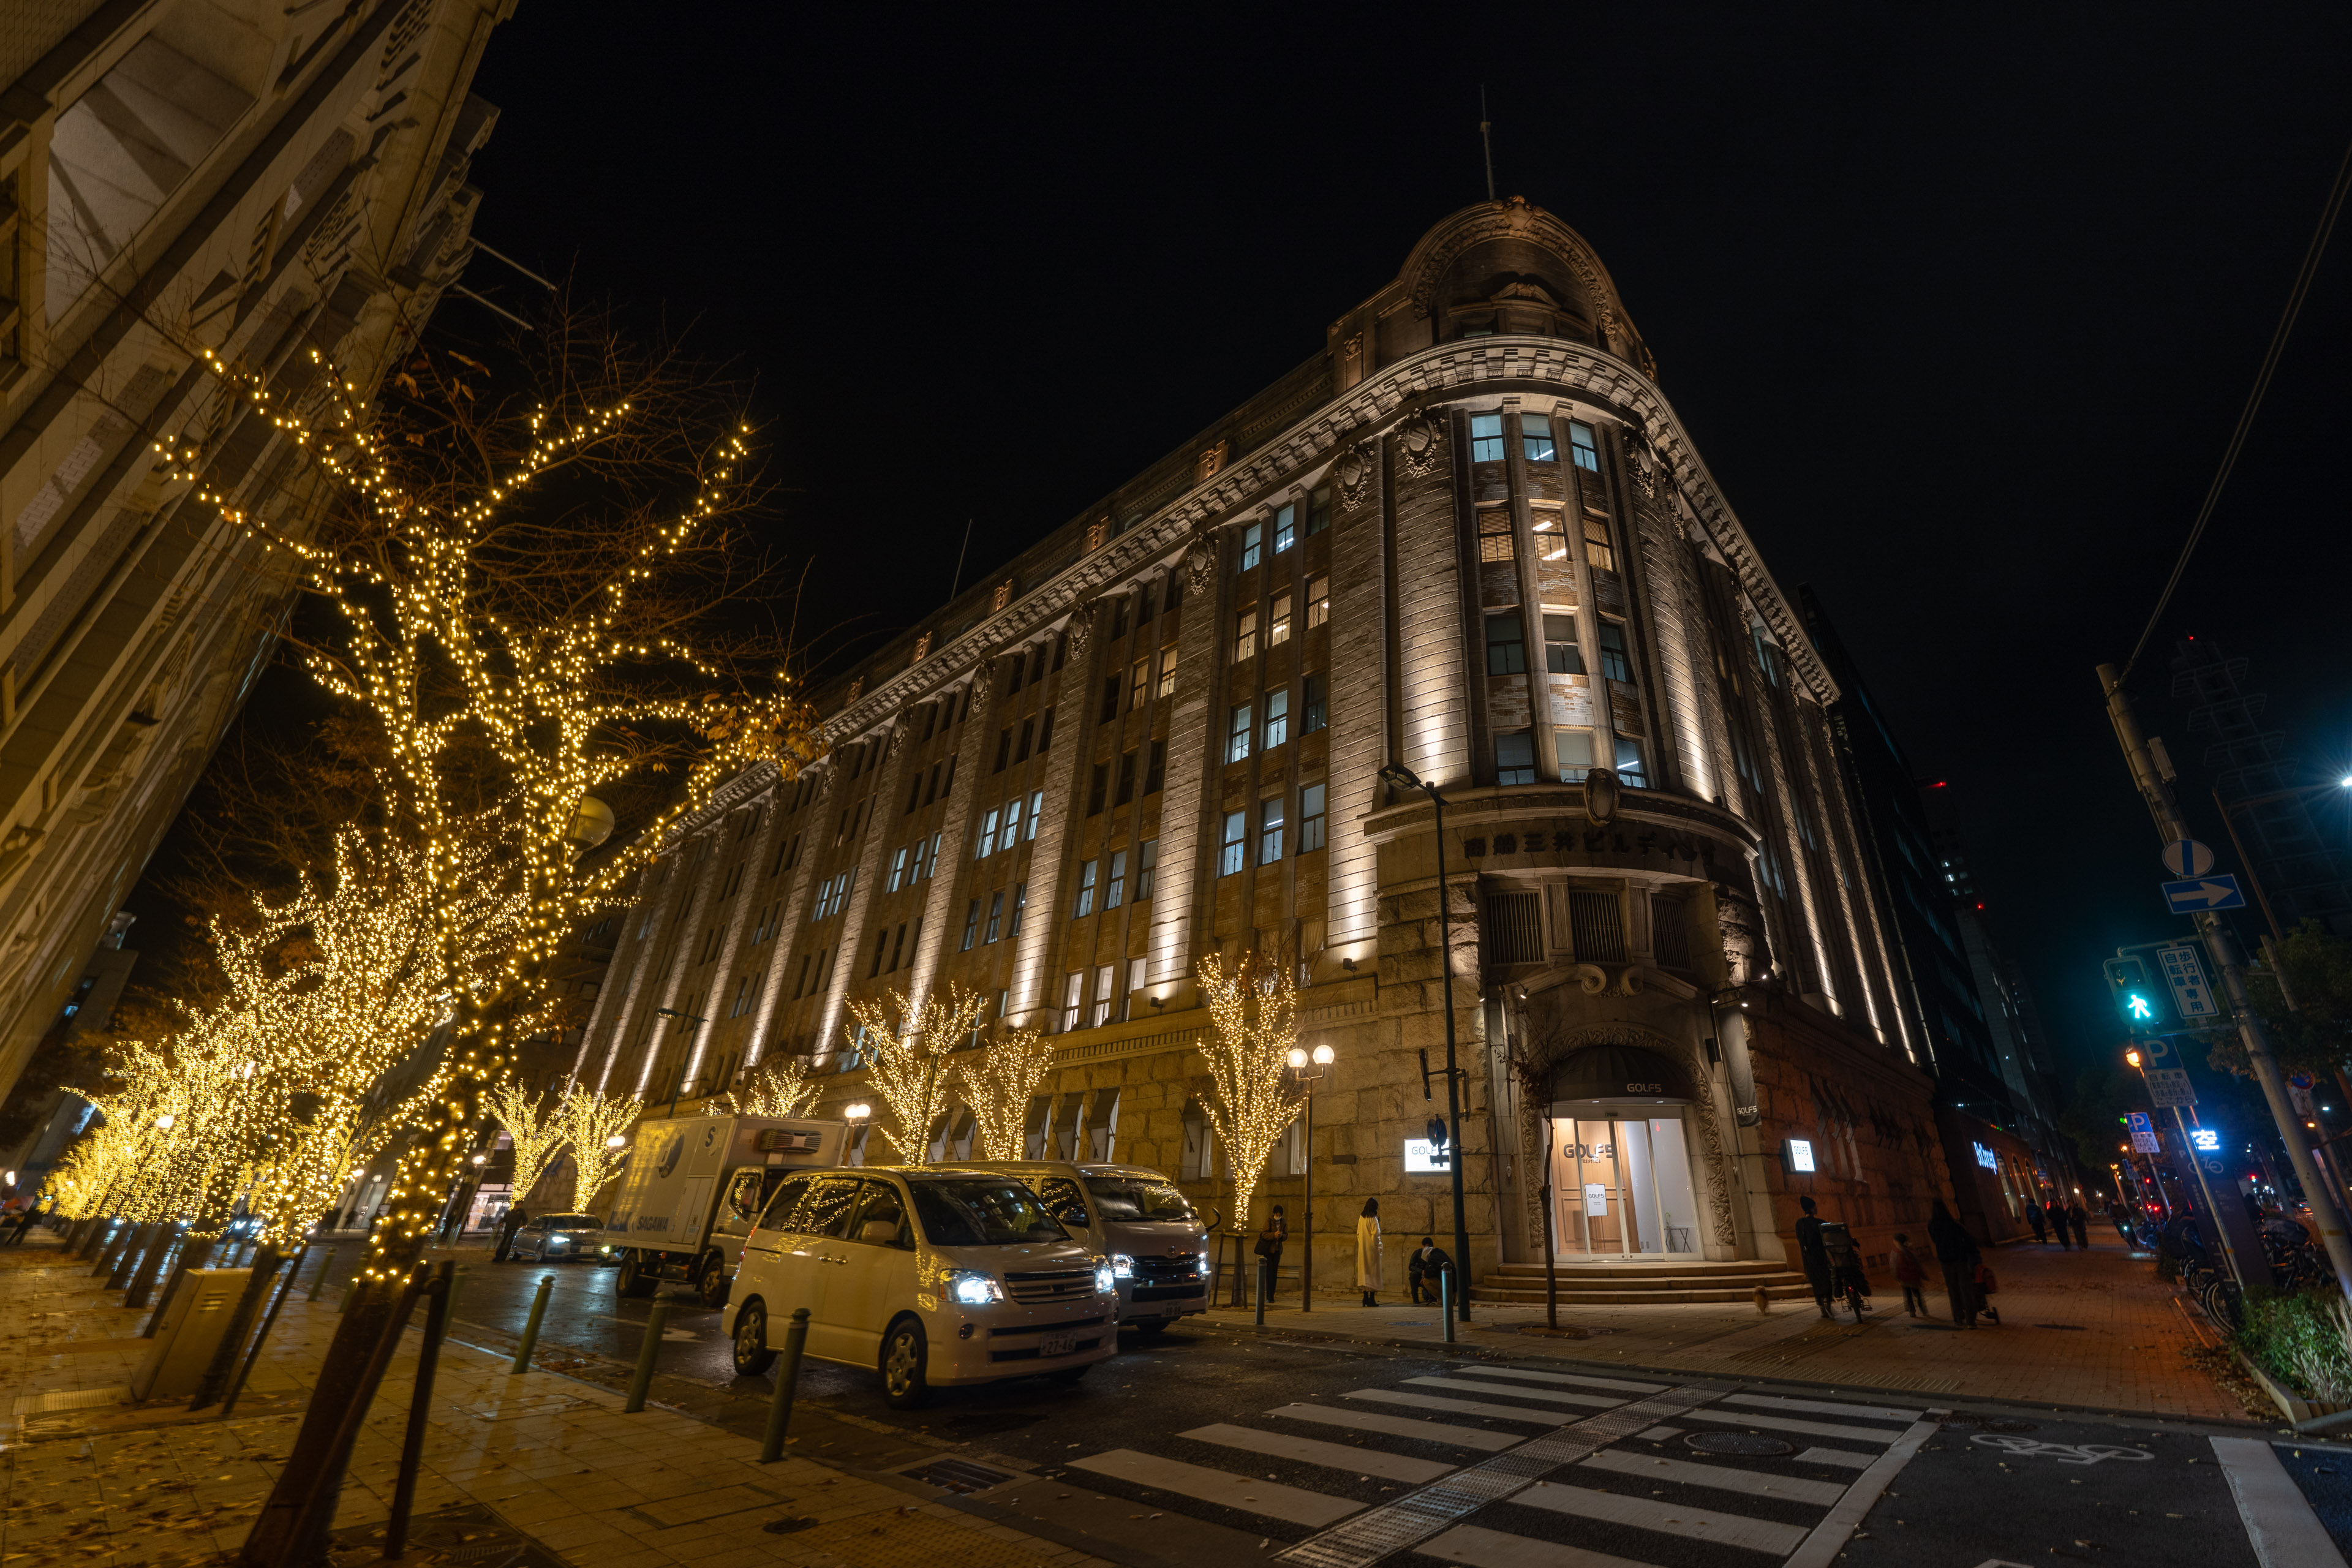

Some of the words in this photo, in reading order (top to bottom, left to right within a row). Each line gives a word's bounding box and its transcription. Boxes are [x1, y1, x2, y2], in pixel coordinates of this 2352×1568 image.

[2165, 954, 2187, 986] 自転車
[2179, 951, 2200, 985] 歩行者
[2185, 989, 2204, 1012] 専用
[2144, 1039, 2168, 1067] P
[1627, 1083, 1662, 1093] GOLF5
[1736, 1105, 1758, 1115] GOLF5
[2131, 1115, 2145, 1131] P
[2192, 1130, 2220, 1150] 空
[1412, 1145, 1444, 1155] GOLF
[1564, 1144, 1612, 1158] GOLF5
[636, 1215, 669, 1232] SAGAWA
